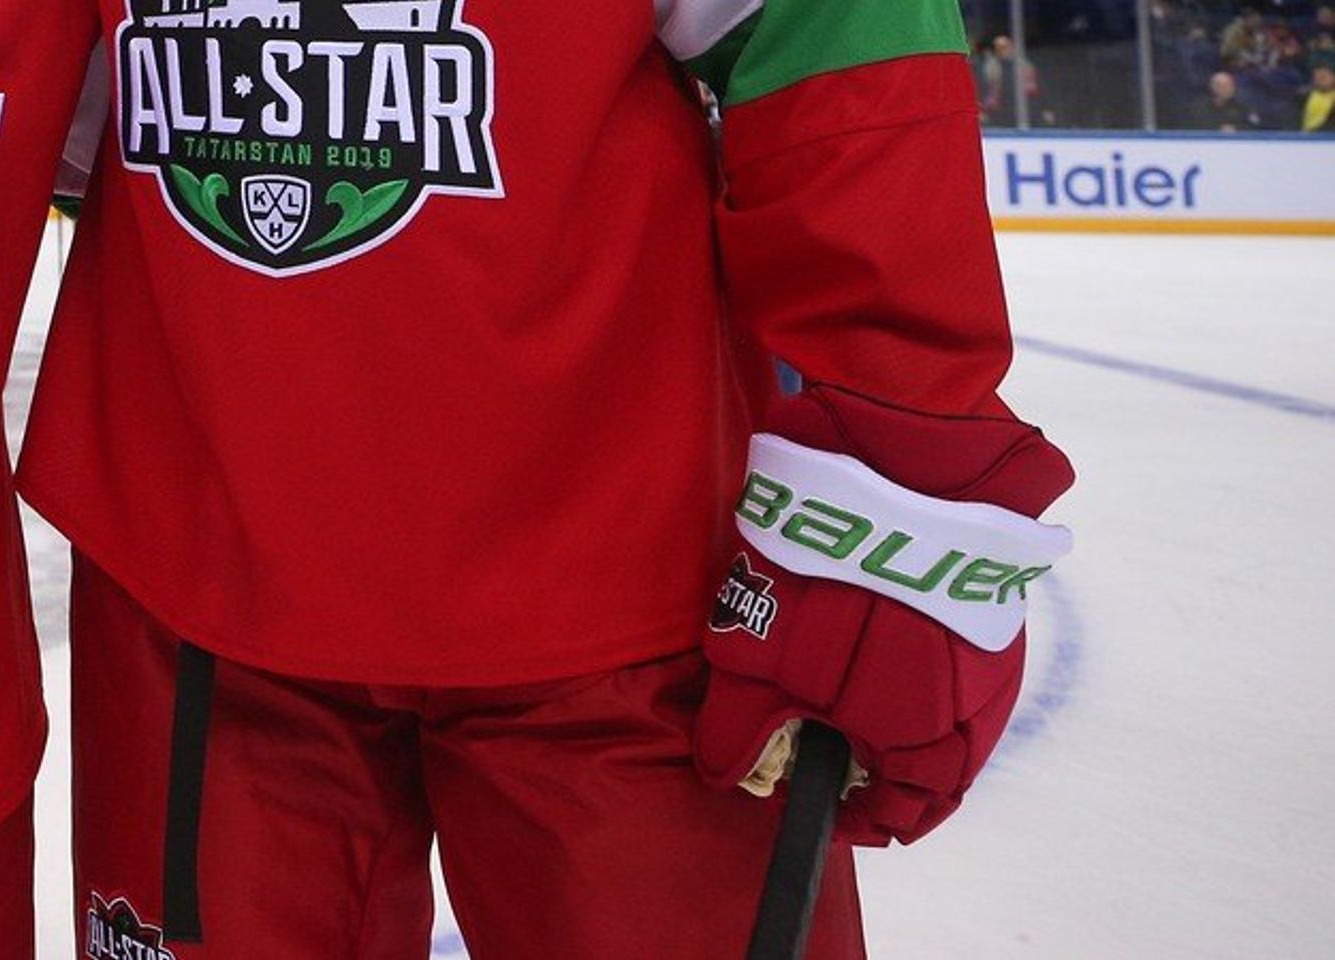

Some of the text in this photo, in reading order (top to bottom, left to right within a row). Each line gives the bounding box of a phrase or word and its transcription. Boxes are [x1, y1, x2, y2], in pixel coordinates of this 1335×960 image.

[184, 137, 393, 171] TATARSTAN 2019
[1006, 152, 1202, 208] Haier
